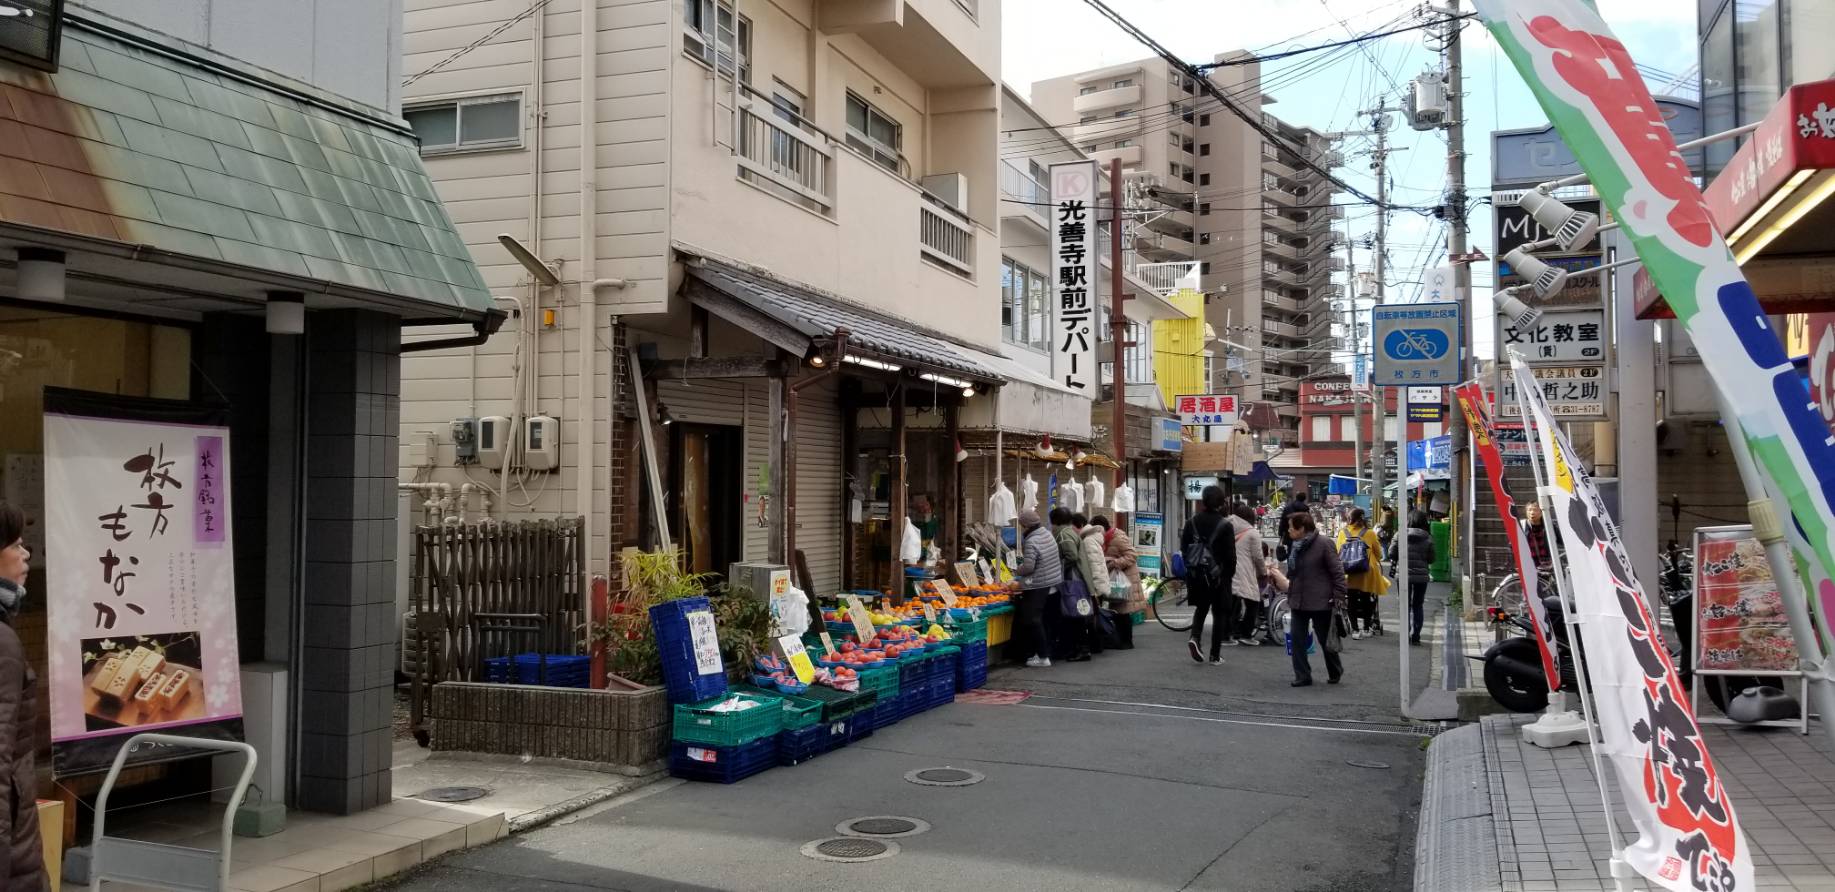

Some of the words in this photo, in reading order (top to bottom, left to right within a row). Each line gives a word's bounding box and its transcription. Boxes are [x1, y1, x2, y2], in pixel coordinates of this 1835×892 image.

[1058, 200, 1091, 389] 光善寺駅前デパート
[1504, 323, 1599, 344] 文化教室
[1314, 382, 1352, 391] CONFE
[1504, 381, 1599, 401] 中哲之助
[1179, 396, 1235, 413] 居酒屋
[124, 442, 182, 539] 枚方
[93, 504, 145, 630] もなか
